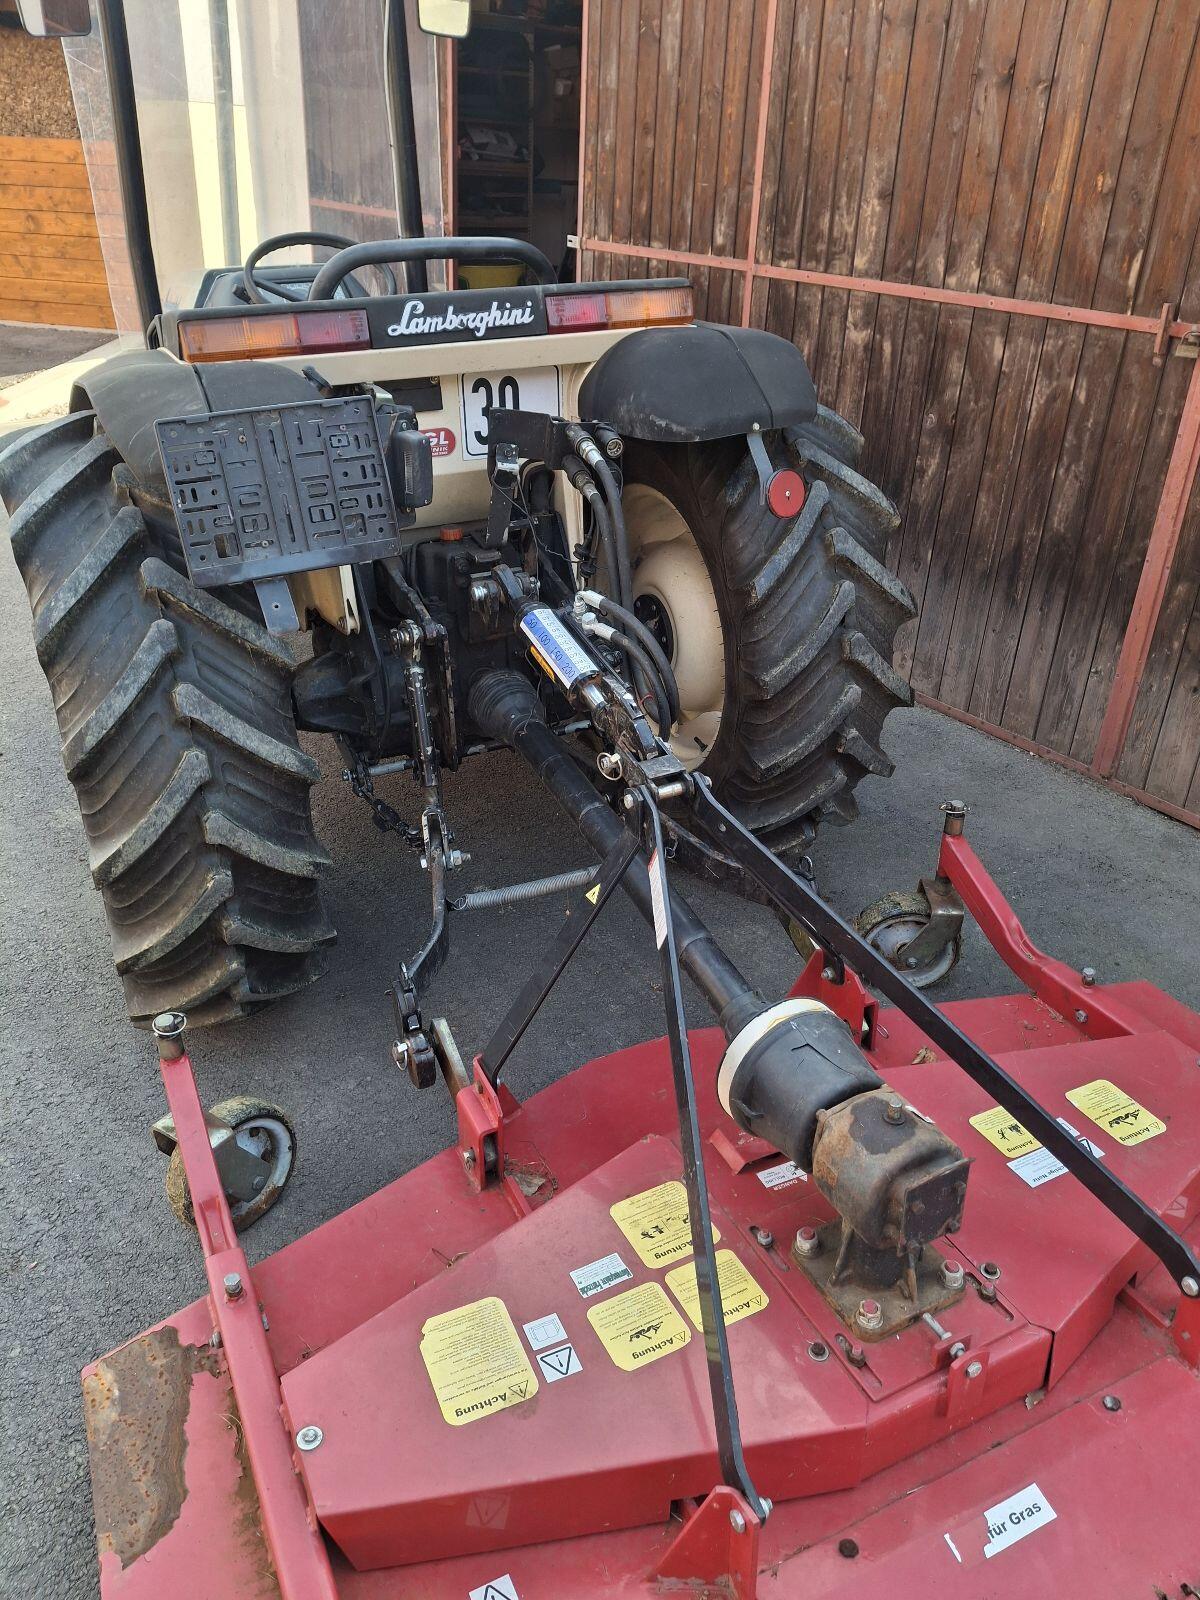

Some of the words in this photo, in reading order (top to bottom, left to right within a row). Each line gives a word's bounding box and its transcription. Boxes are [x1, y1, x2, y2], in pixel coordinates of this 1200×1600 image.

[388, 300, 534, 337] Lamborghini
[1119, 1126, 1150, 1142] Achtung
[722, 1301, 751, 1317] Achtu
[631, 1337, 674, 1360] Achtung
[455, 1392, 507, 1418] Achtung
[987, 1522, 1008, 1539] für
[1008, 1502, 1042, 1526] Gras
